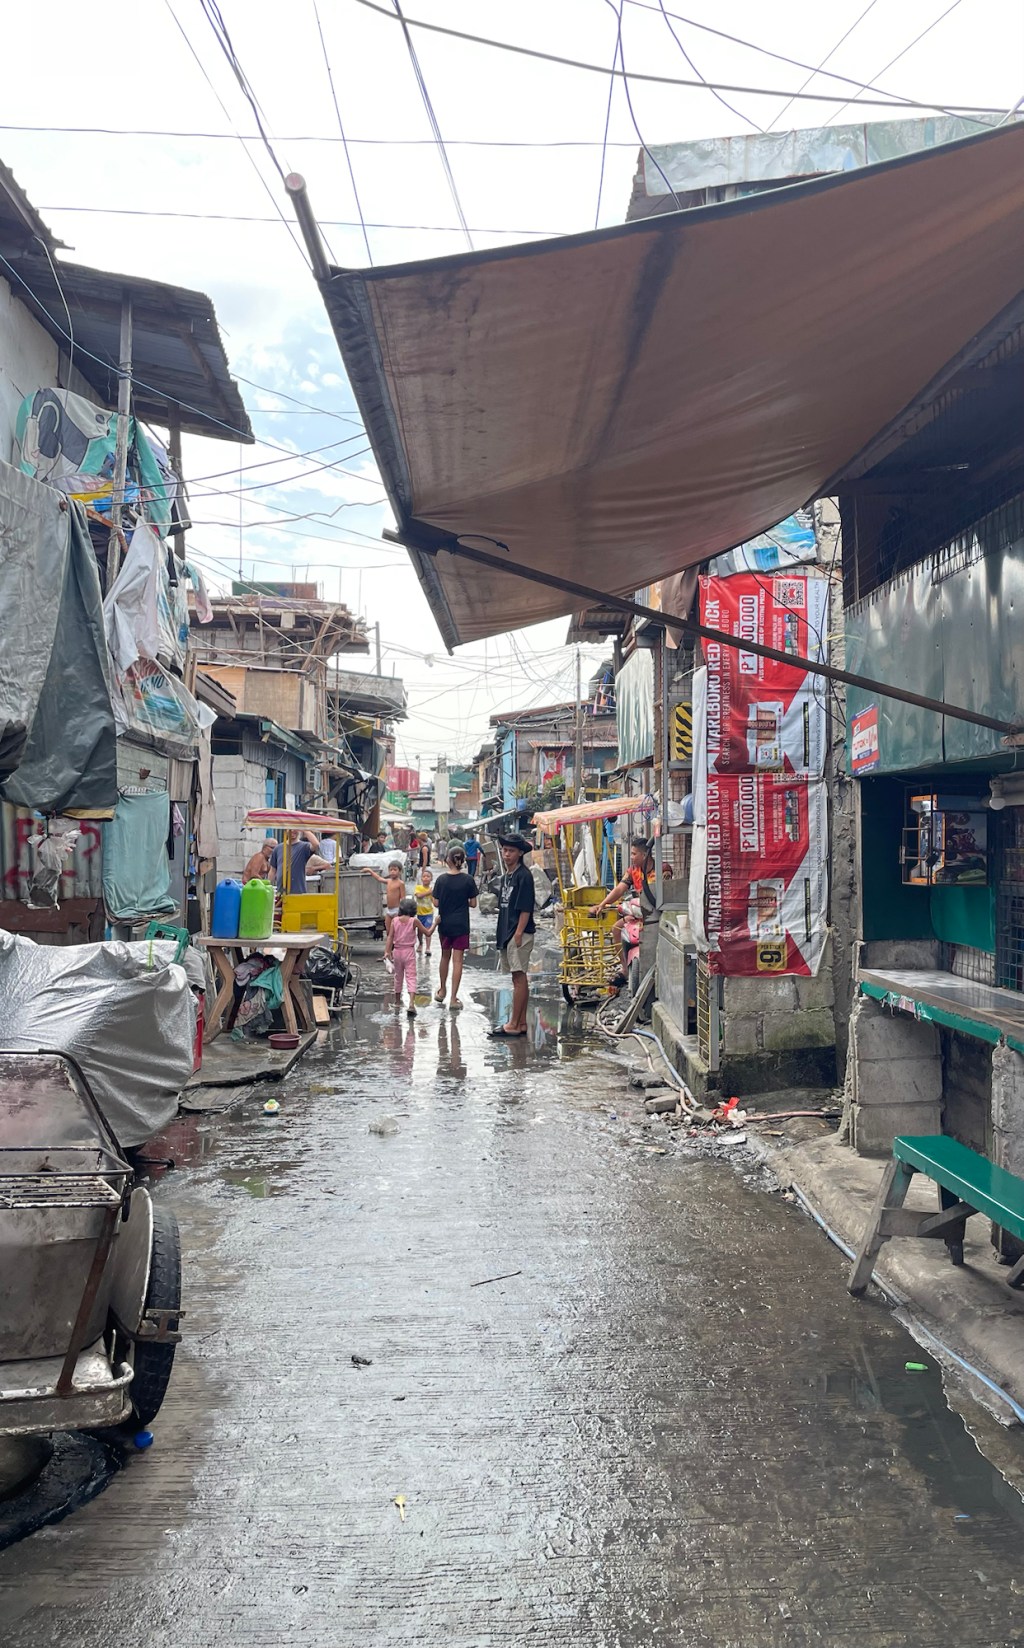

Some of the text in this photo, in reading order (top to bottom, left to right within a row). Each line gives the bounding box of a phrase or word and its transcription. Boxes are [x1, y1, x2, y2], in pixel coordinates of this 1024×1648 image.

[706, 643, 721, 671] RED
[707, 674, 721, 750] MARLBORO
[722, 681, 730, 720] GREATNESS
[721, 739, 731, 765] SEARCH
